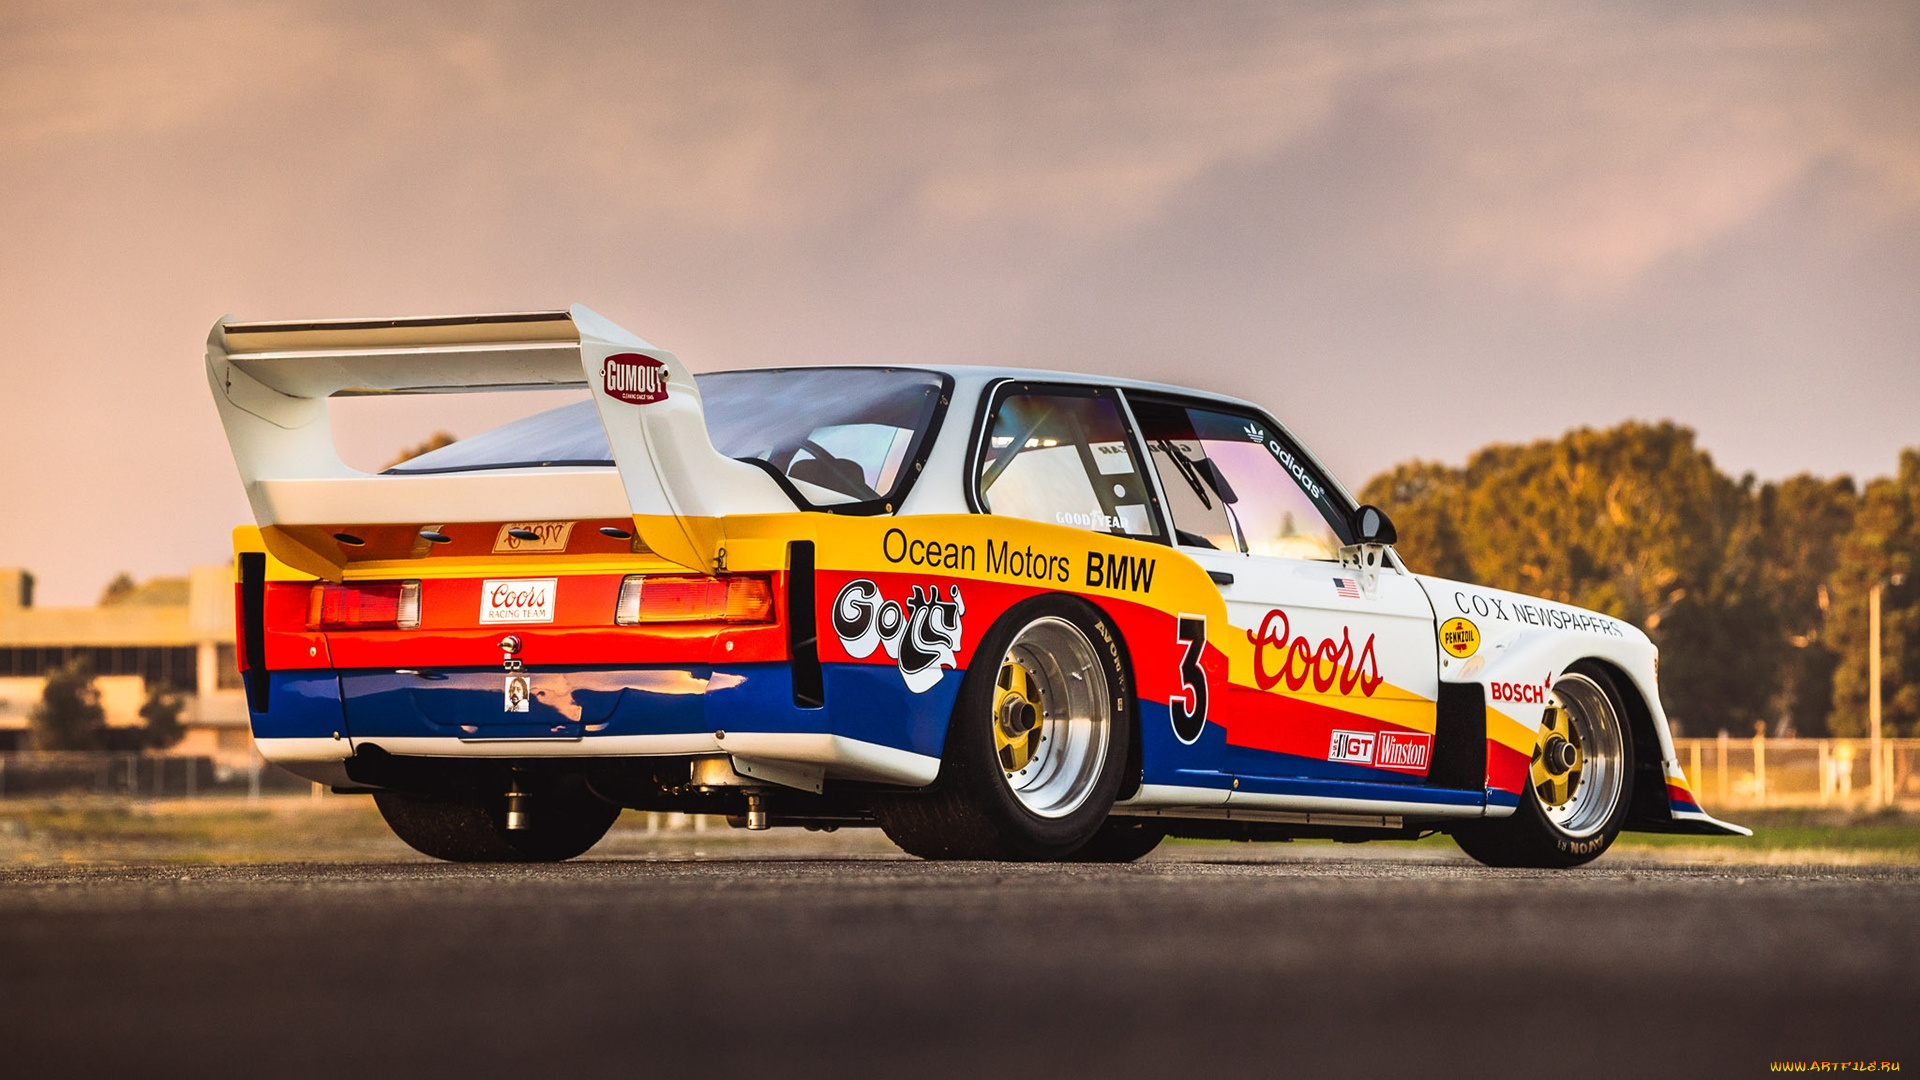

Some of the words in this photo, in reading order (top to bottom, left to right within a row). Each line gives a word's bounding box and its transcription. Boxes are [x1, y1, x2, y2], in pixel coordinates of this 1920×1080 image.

[607, 360, 662, 393] GUMOUT
[883, 528, 976, 572] Ocean
[986, 539, 1070, 583] Motors
[1085, 551, 1156, 593] BMW
[490, 583, 546, 608] Coors
[488, 610, 520, 618] RACING
[523, 609, 546, 617] TEAM
[1445, 630, 1475, 644] PENNZOIL
[1247, 609, 1384, 697] Coors
[1169, 612, 1209, 745] 3
[1490, 682, 1544, 704] BOSCH
[1348, 738, 1373, 756] GT
[1381, 735, 1426, 765] Winston
[1570, 833, 1604, 855] AVON
